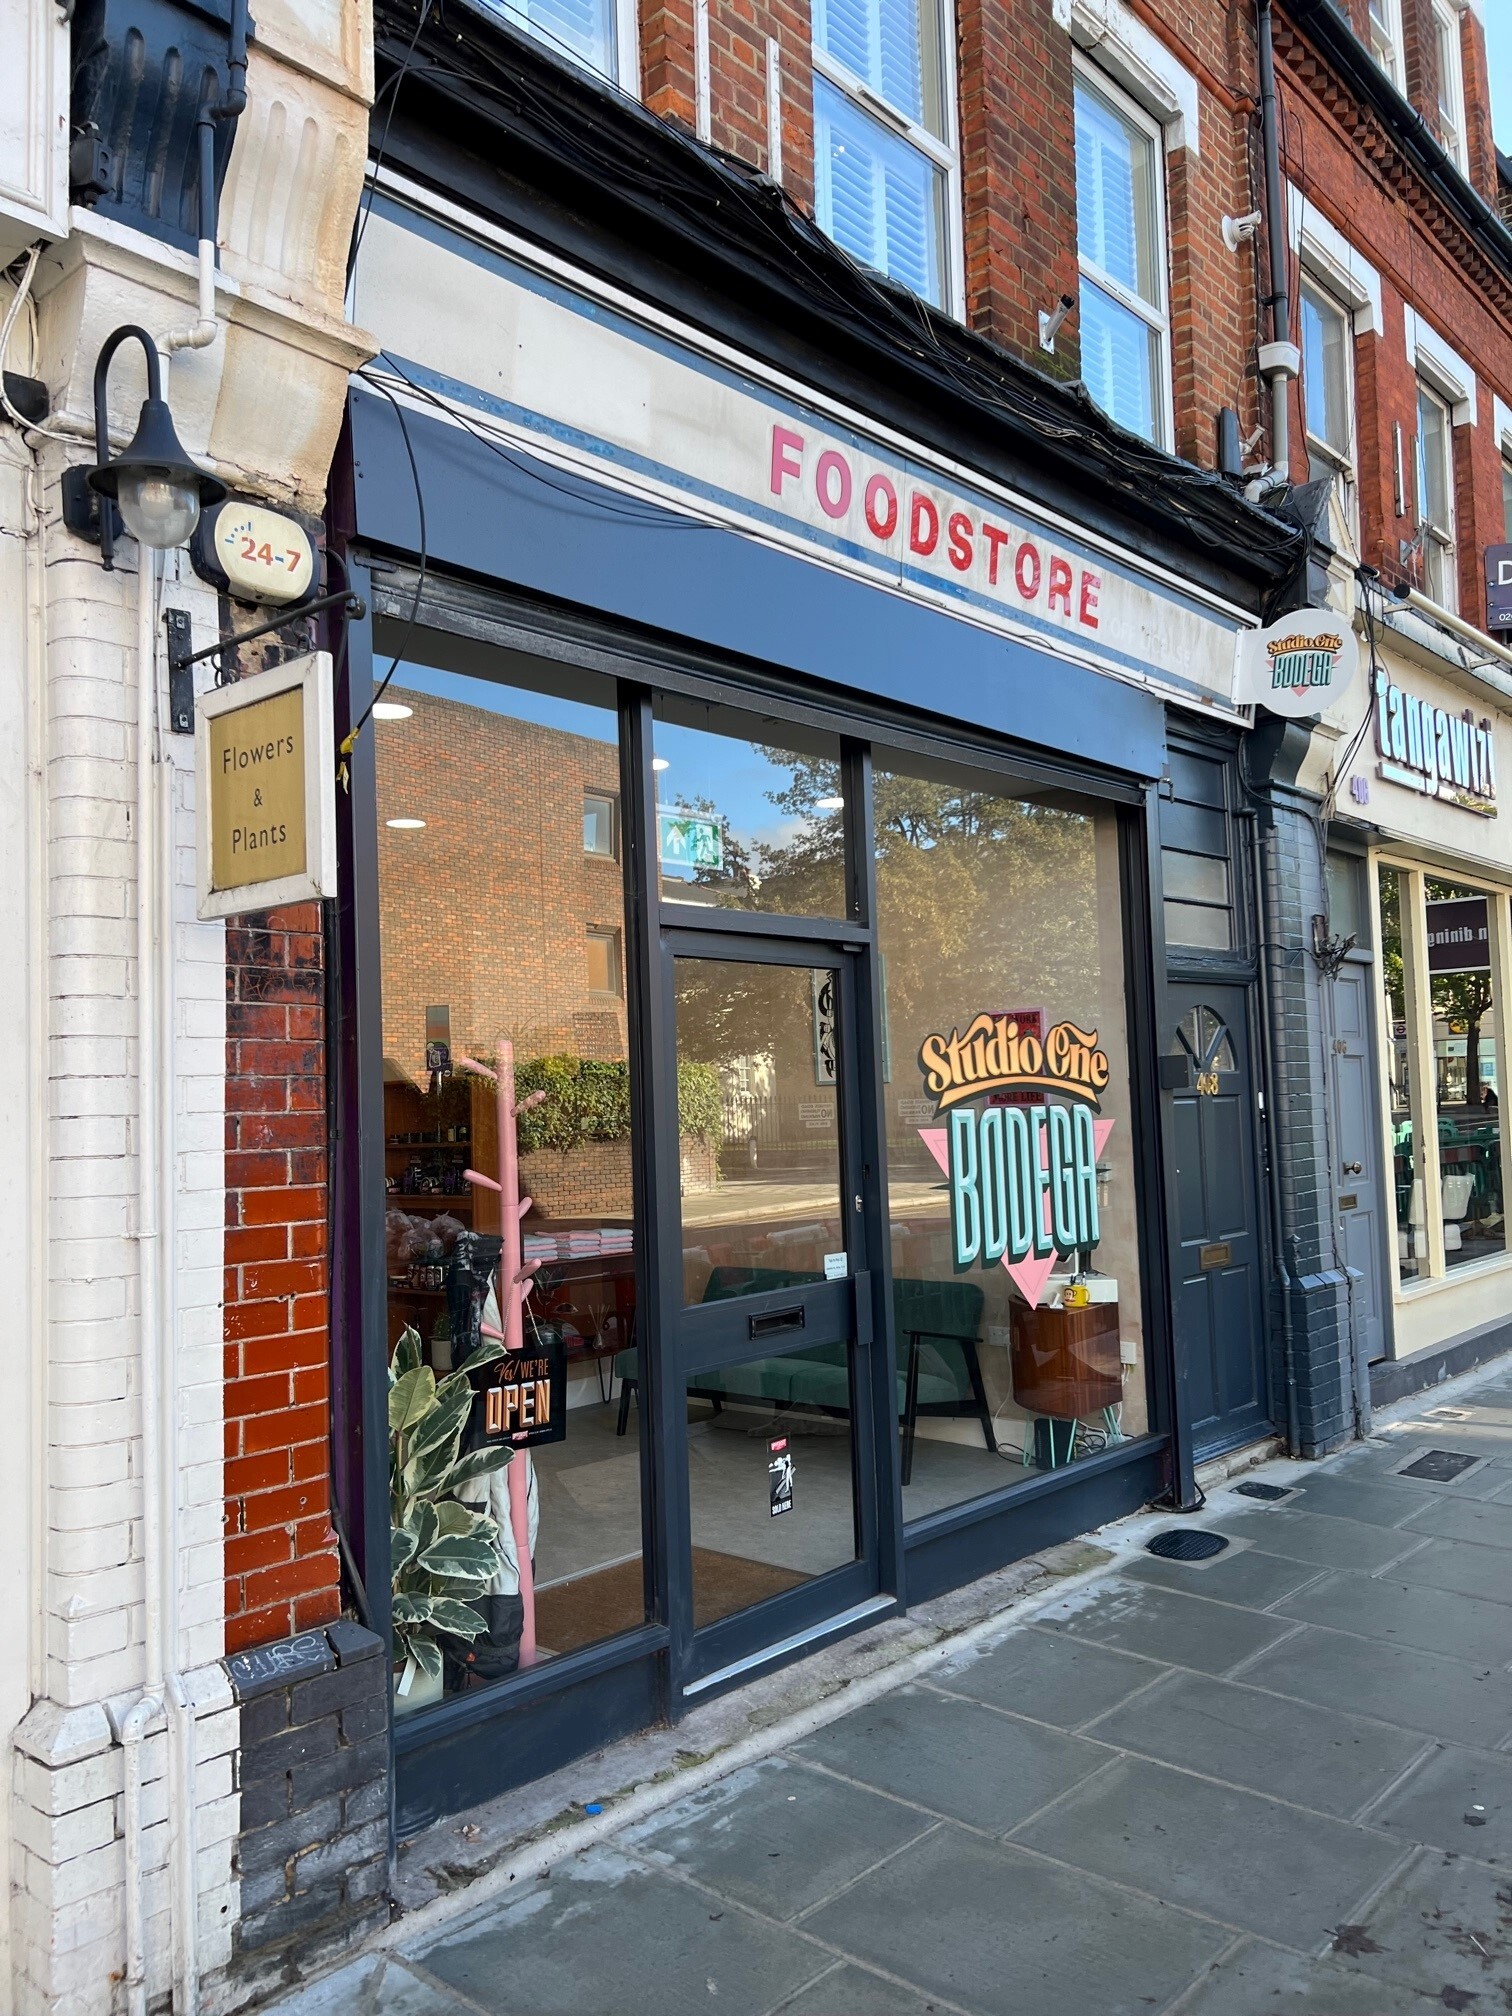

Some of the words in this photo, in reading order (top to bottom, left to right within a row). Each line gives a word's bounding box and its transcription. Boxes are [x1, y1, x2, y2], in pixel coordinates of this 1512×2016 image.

[770, 424, 1101, 629] FOODSTORE
[241, 536, 302, 573] 24-7
[1267, 634, 1314, 653] Studio
[1314, 632, 1343, 650] One
[1272, 652, 1334, 689] BODEGA
[1375, 666, 1496, 800] tangawizi
[223, 735, 294, 774] Flowers
[253, 788, 263, 807] &
[232, 824, 287, 854] Plants
[920, 1013, 1043, 1092] Studio
[1046, 1021, 1110, 1087] One
[1196, 1072, 1220, 1096] 408
[949, 1104, 1100, 1268] BODEGA
[493, 1360, 520, 1384] Yes!
[521, 1359, 549, 1379] WE'RE
[486, 1379, 551, 1434] OPEN
